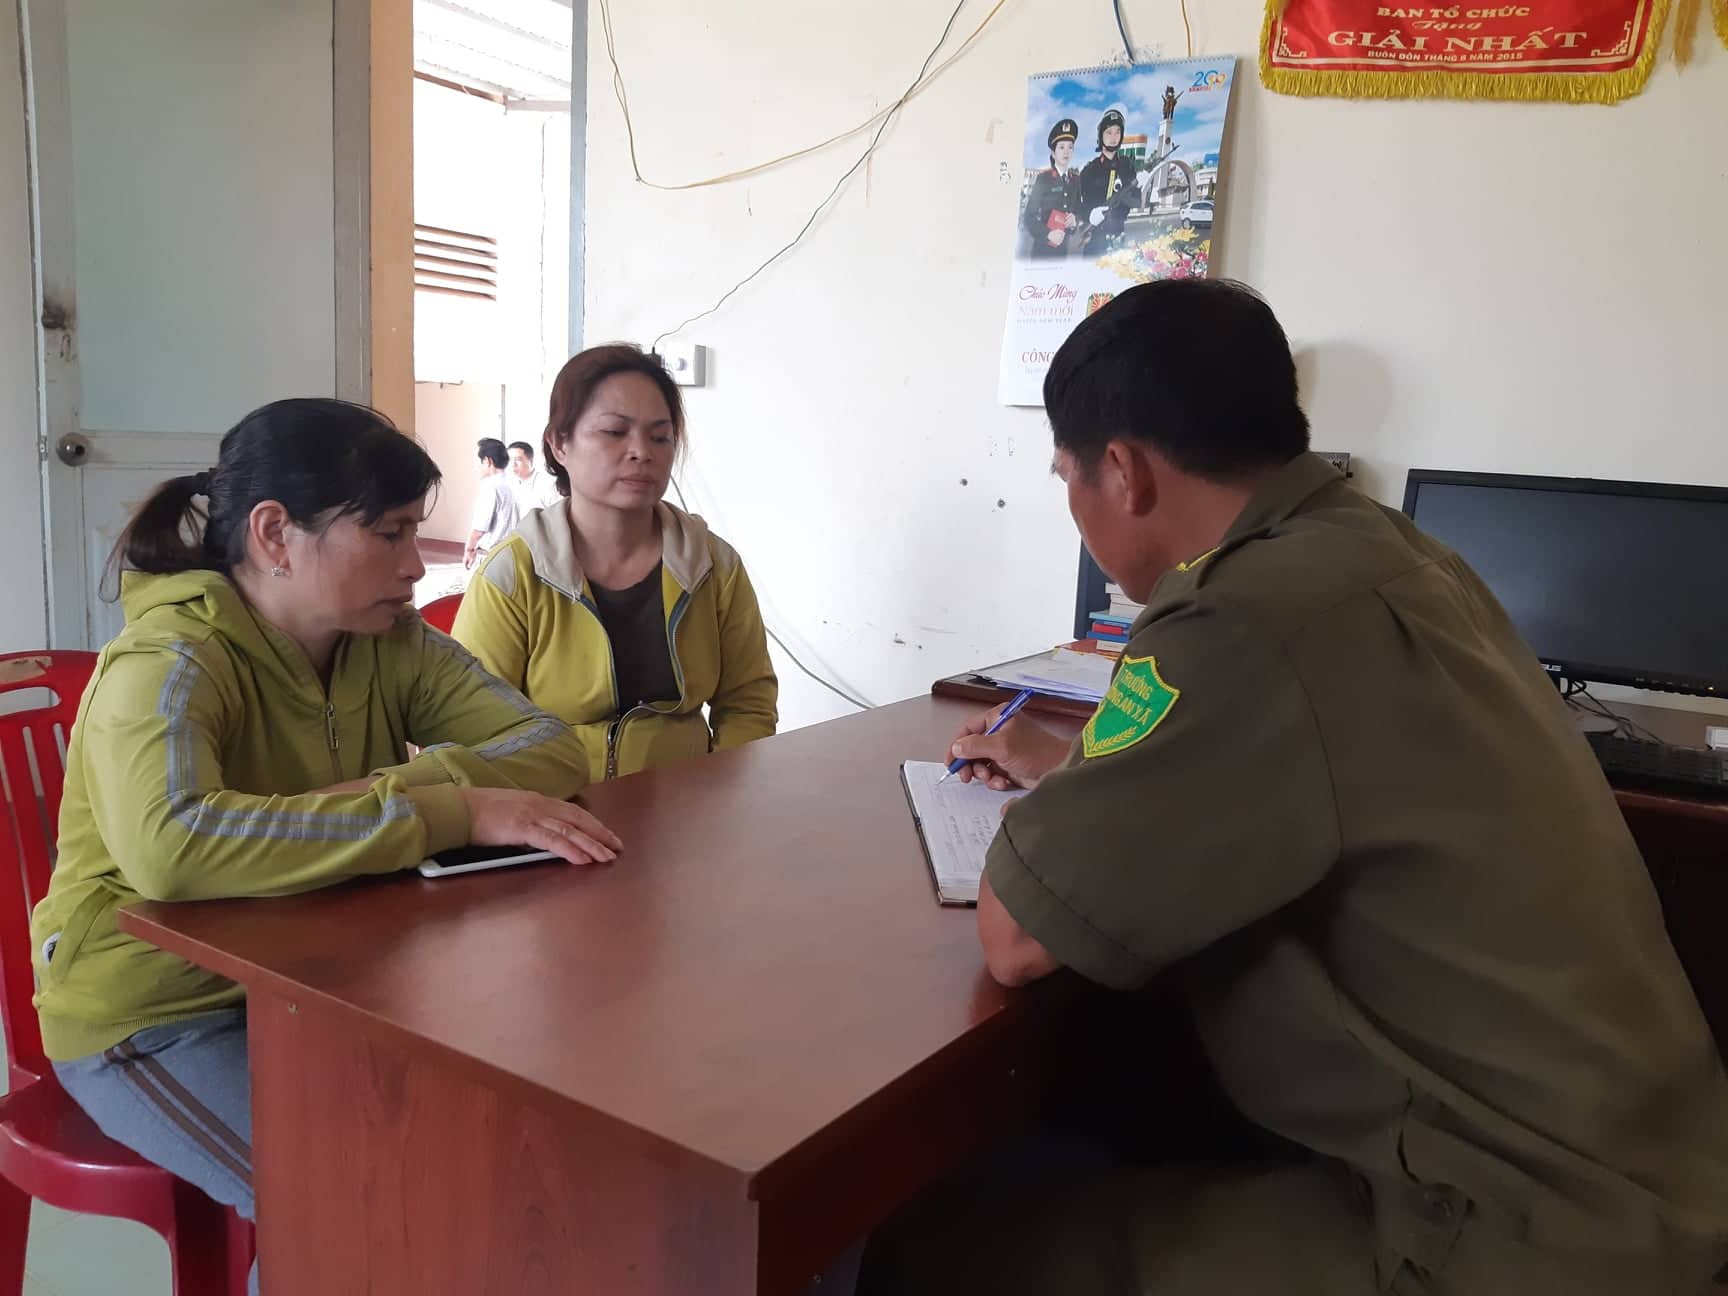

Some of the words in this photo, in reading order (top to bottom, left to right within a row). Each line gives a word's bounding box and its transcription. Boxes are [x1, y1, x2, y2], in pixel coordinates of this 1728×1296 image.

[1377, 7, 1424, 18] BAN
[1430, 5, 1460, 18] TỔ
[1466, 6, 1530, 18] CHỨC
[1328, 29, 1429, 51] GIẢI
[1443, 26, 1587, 52] NHẤT
